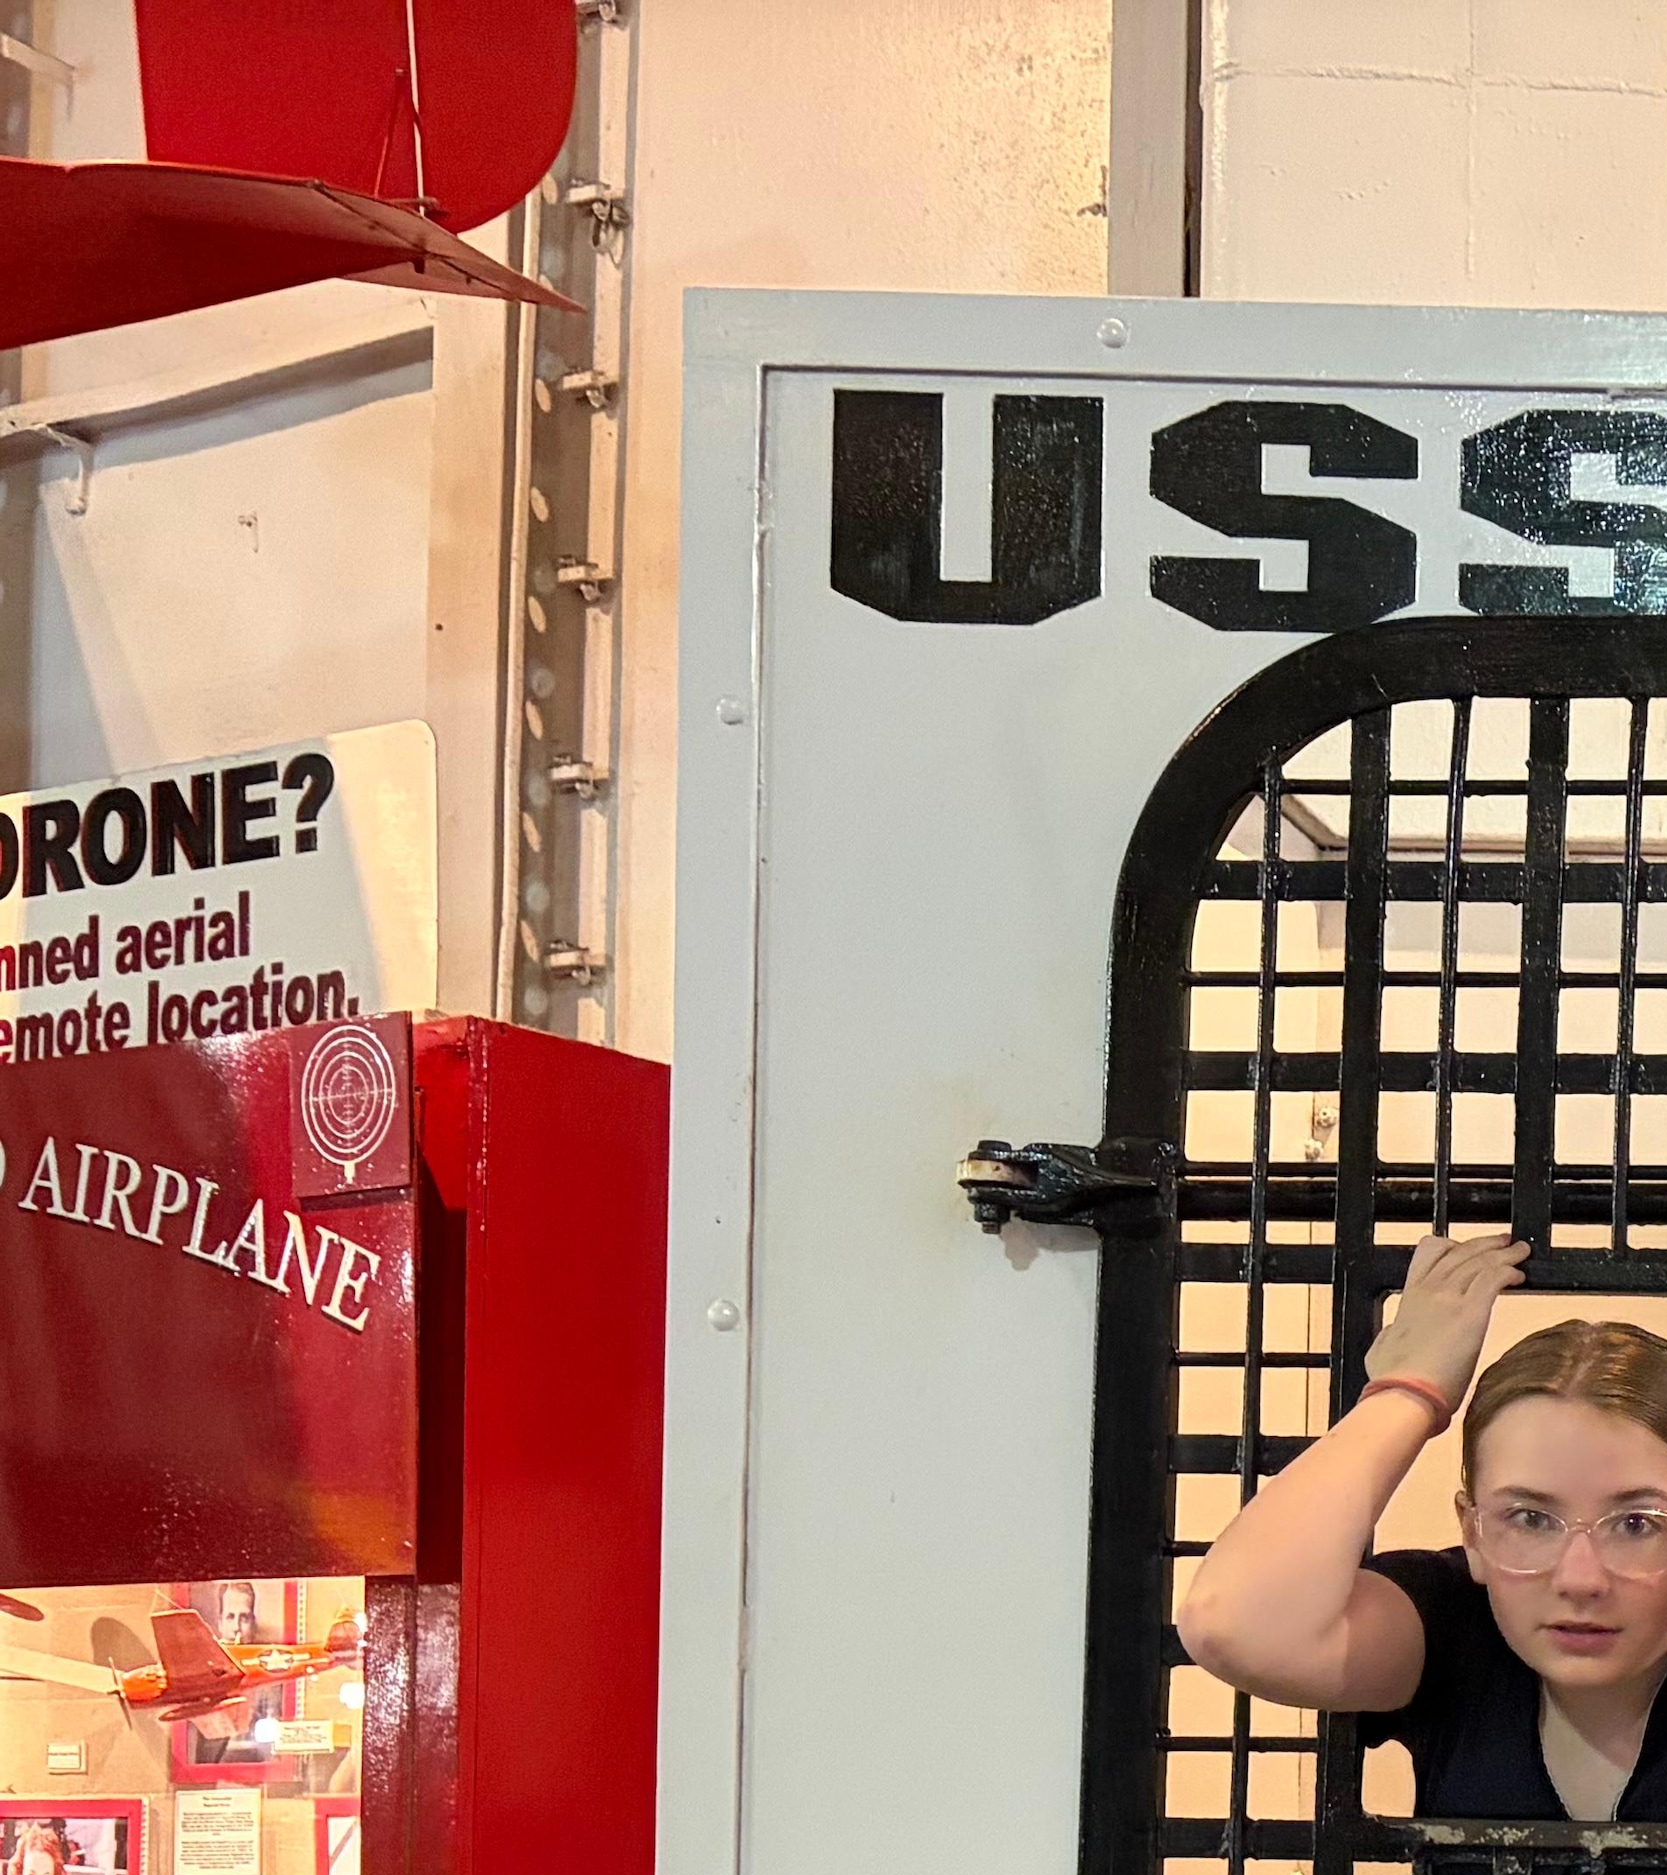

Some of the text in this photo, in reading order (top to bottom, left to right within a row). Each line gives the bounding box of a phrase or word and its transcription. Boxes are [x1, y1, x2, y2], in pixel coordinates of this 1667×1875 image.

[0, 753, 335, 900] RONE?
[115, 890, 250, 975] aerial
[18, 1136, 380, 1331] AIRPLANE
